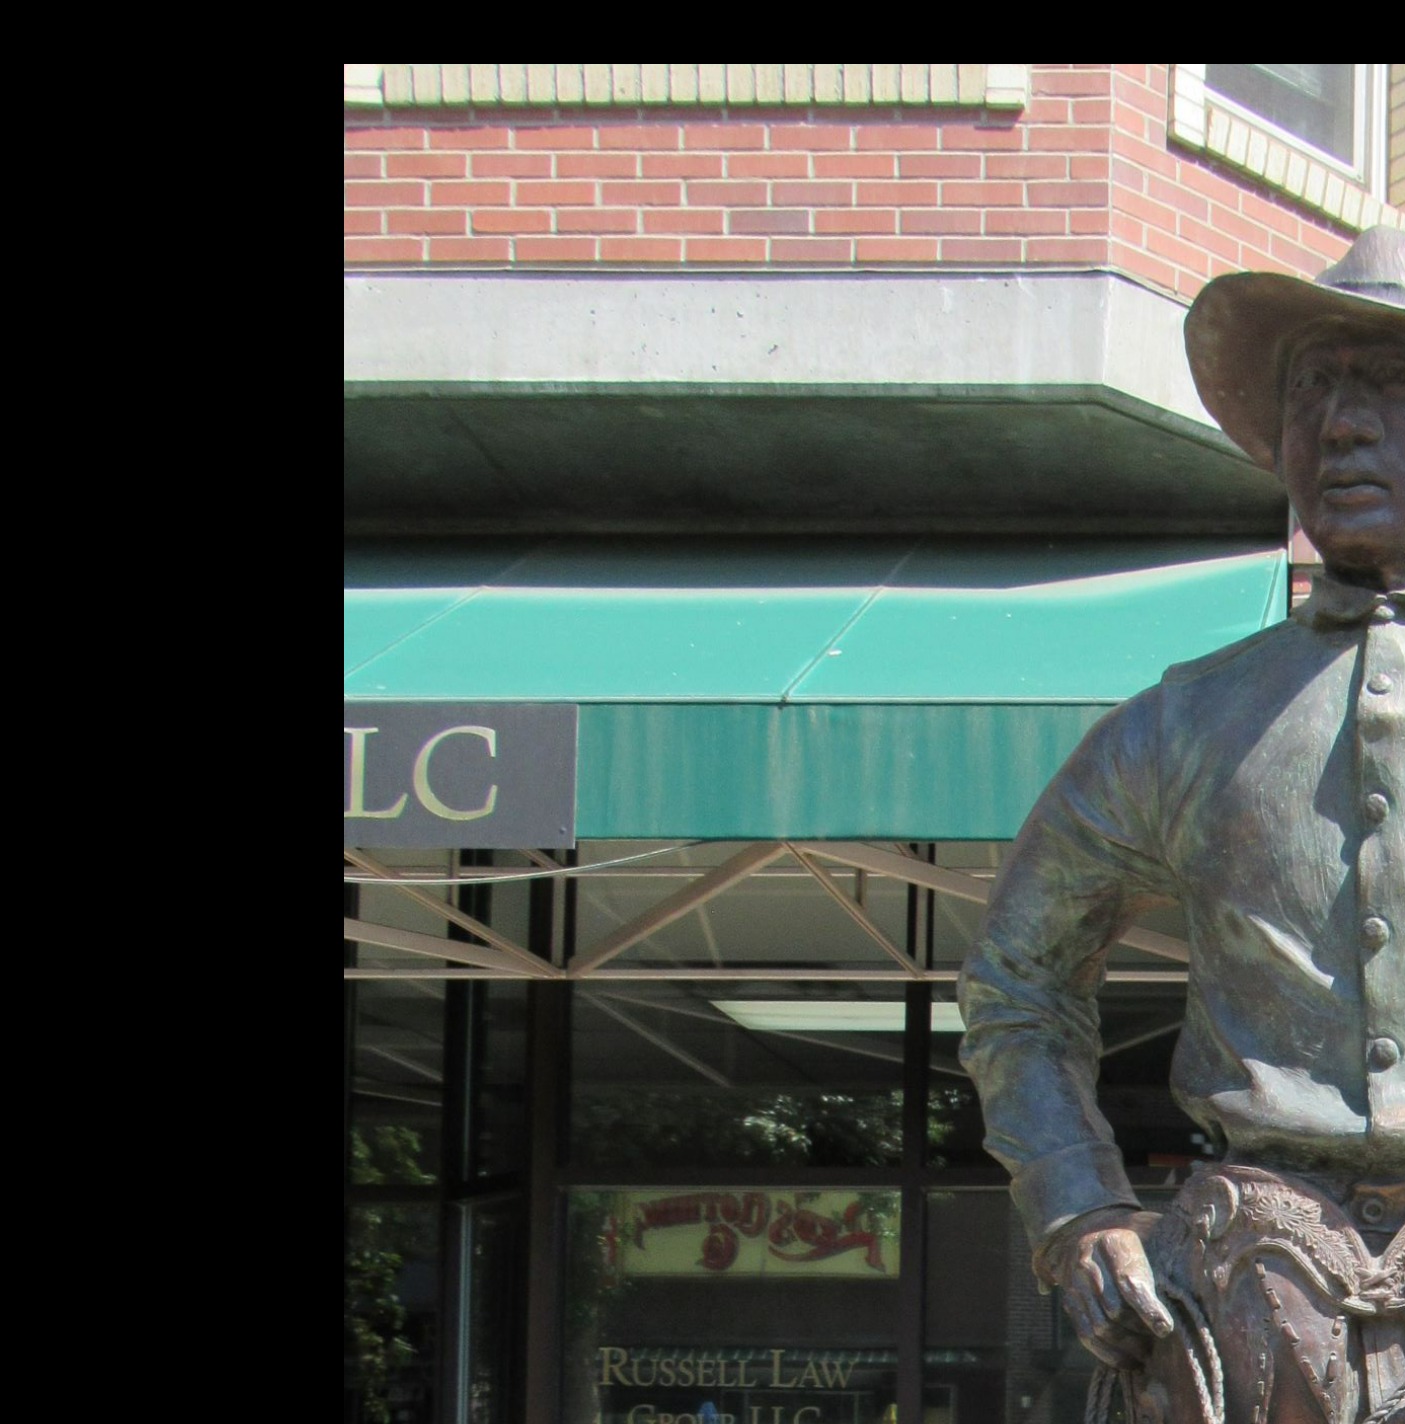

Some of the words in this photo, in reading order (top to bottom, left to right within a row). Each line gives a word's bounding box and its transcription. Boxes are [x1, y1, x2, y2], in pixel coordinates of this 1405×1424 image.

[344, 725, 498, 821] LC
[599, 1346, 757, 1387] RUSSELL
[769, 1348, 859, 1388] LAW
